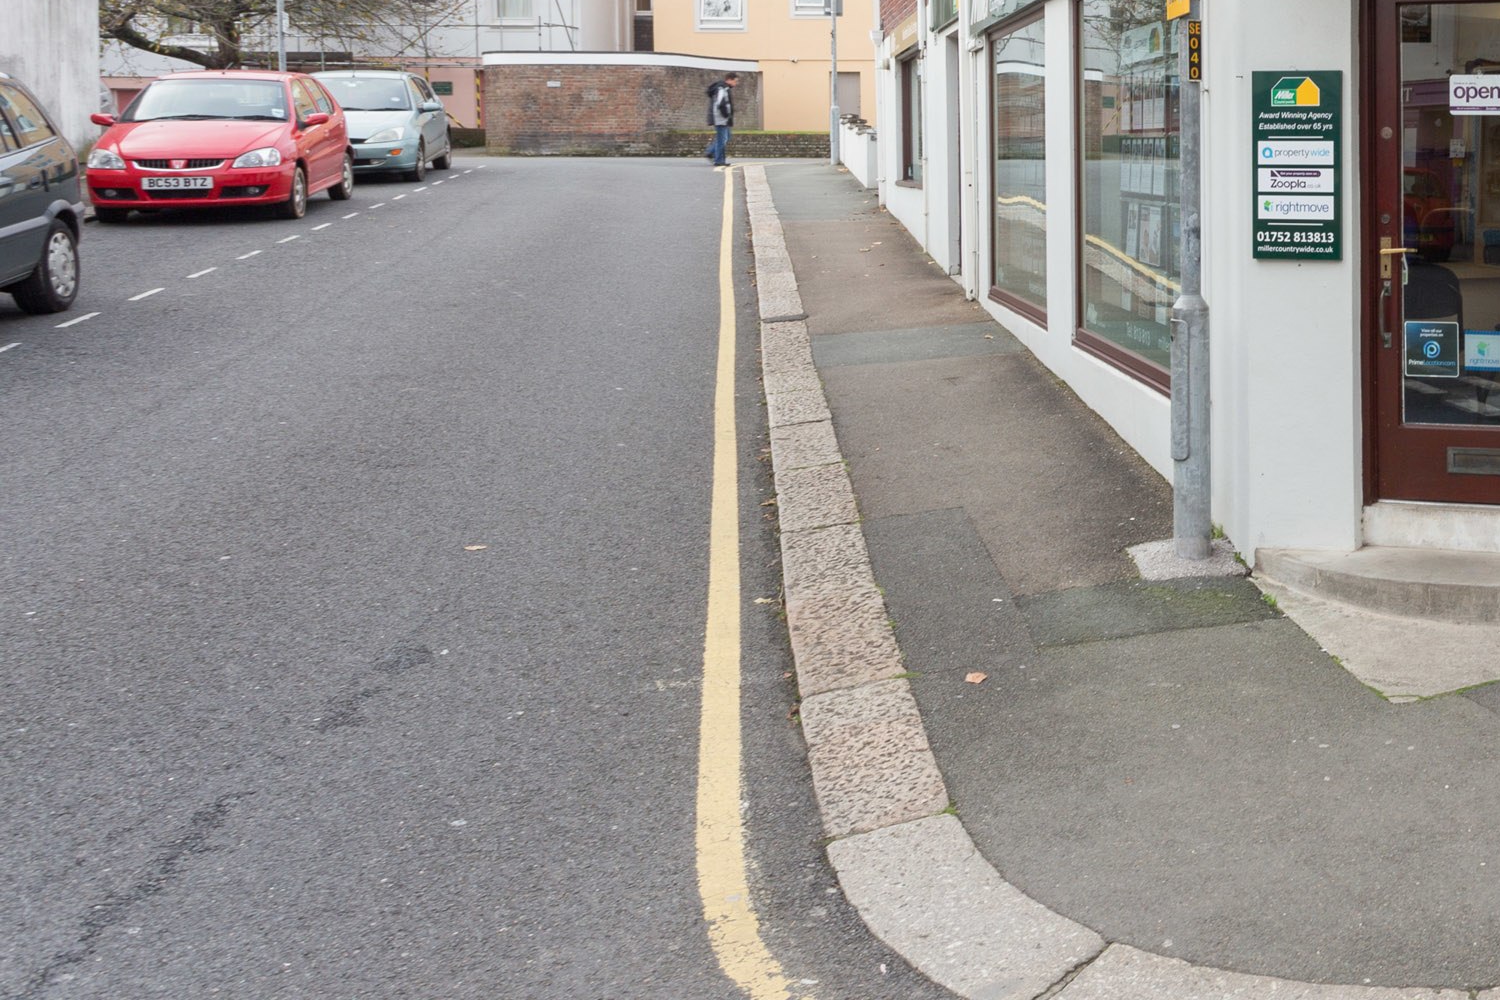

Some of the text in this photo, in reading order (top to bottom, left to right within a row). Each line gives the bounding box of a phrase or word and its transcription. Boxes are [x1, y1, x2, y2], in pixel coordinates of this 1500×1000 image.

[1189, 23, 1200, 34] SE
[1274, 90, 1294, 99] Miller
[1454, 86, 1500, 102] open
[1281, 112, 1306, 120] Winning
[1308, 112, 1333, 120] Agency
[148, 178, 207, 187] BC53 BTZ
[1276, 200, 1329, 214] rightmove
[1257, 232, 1334, 243] 01752 813813
[1258, 245, 1333, 253] millercountrywide.co.uk
